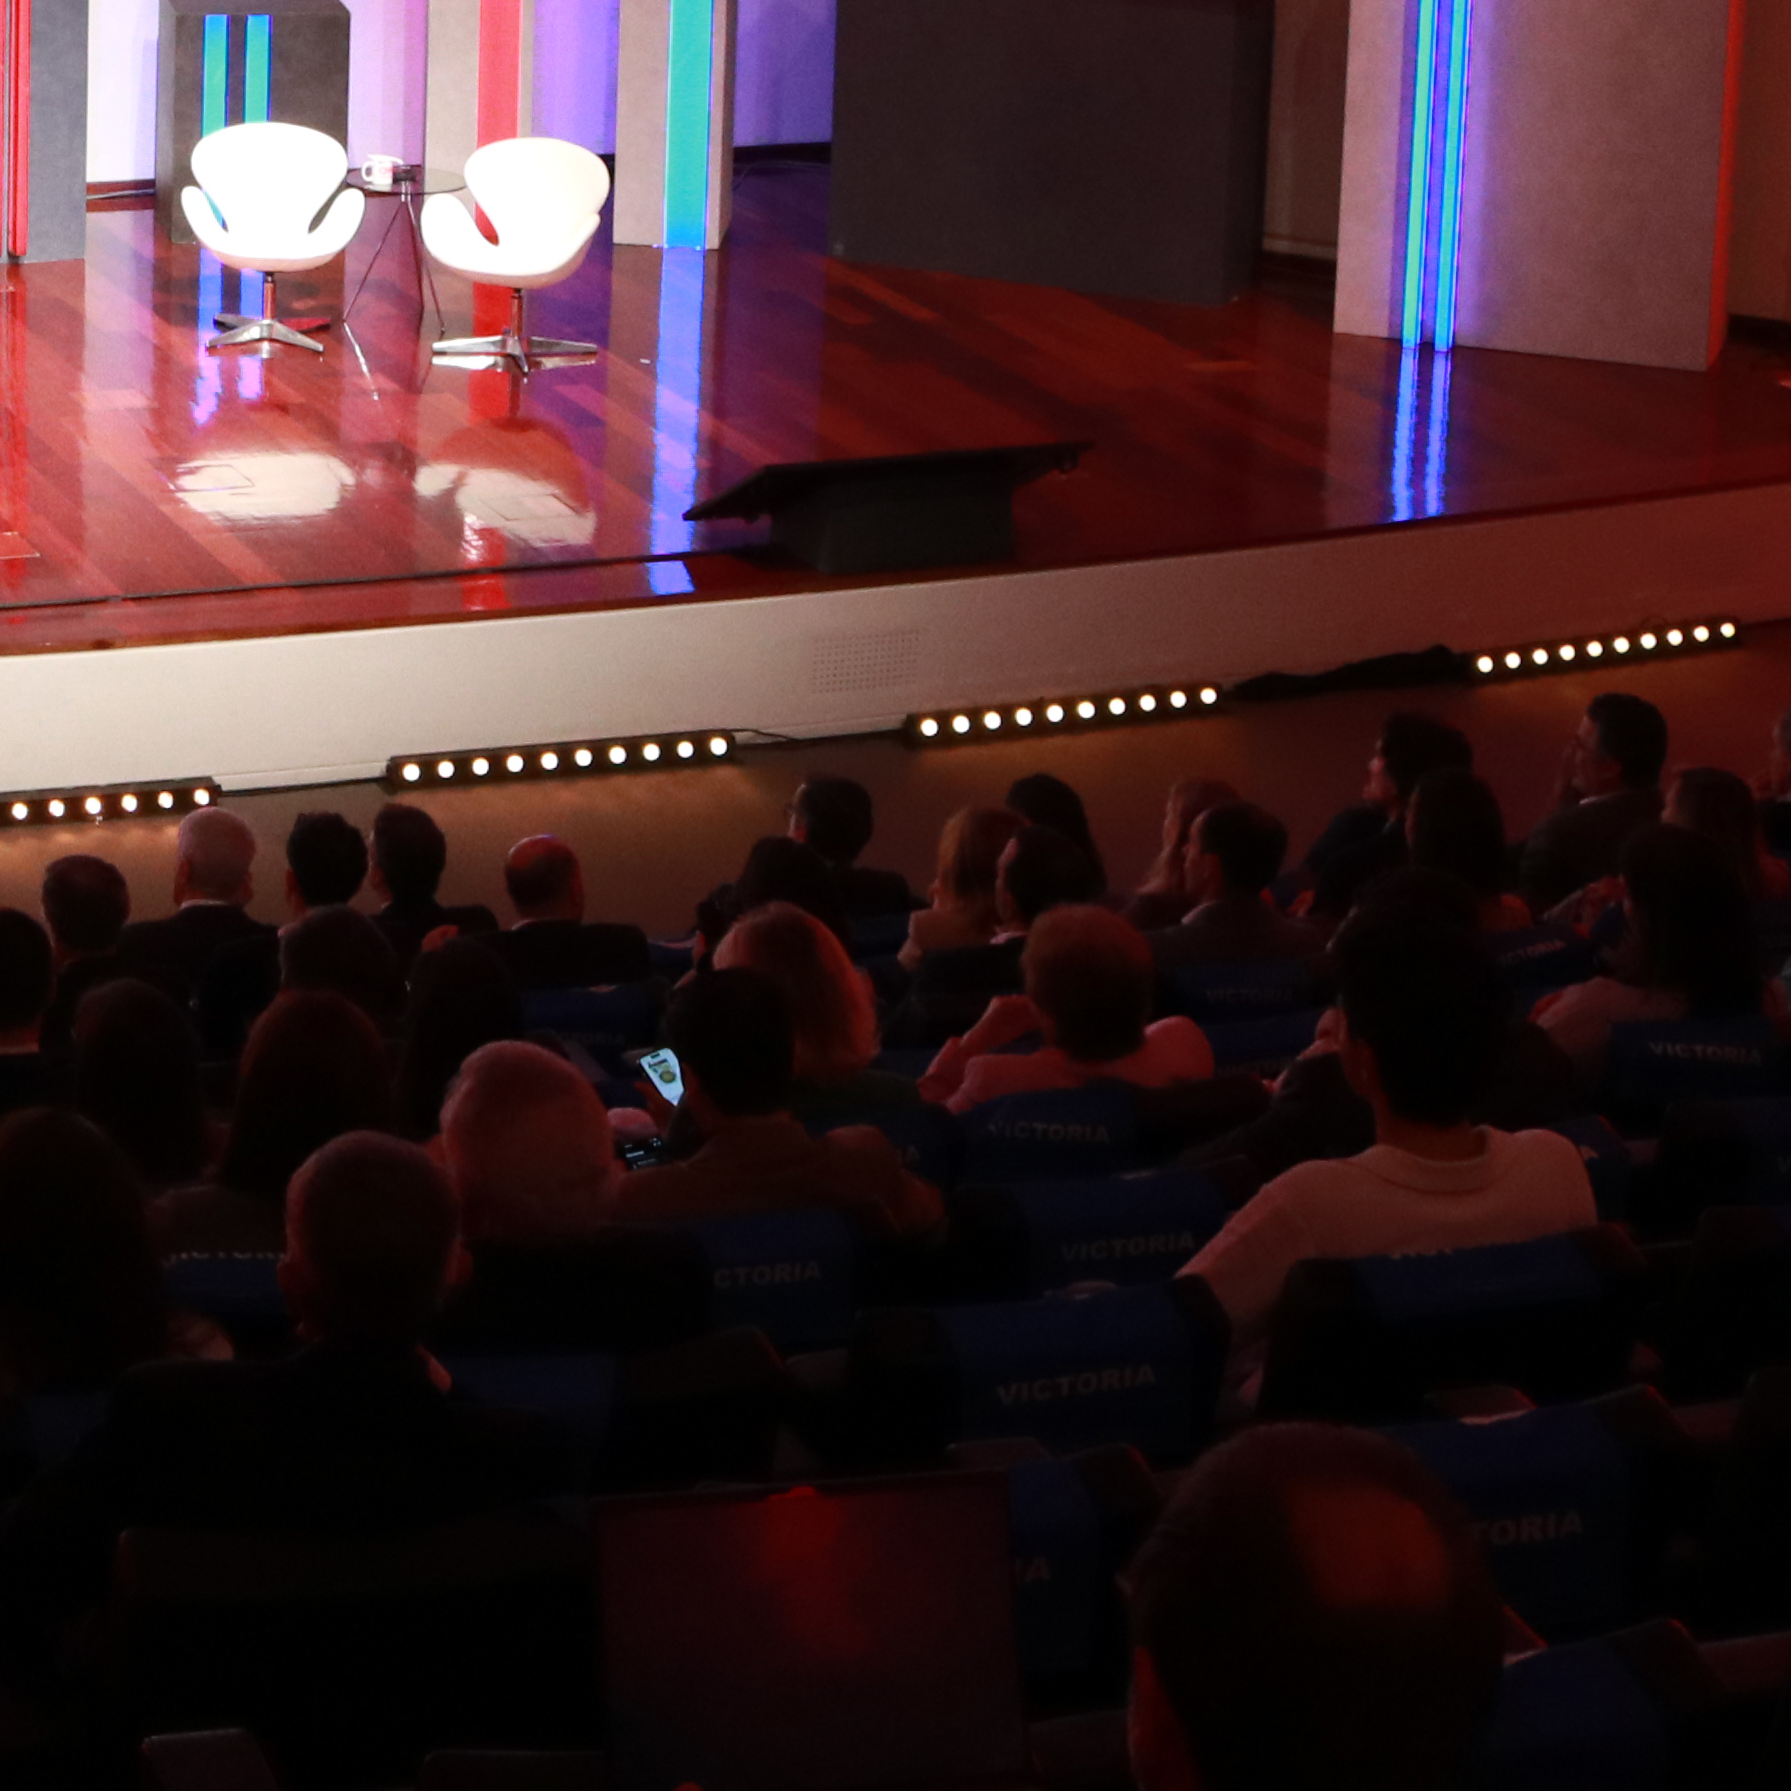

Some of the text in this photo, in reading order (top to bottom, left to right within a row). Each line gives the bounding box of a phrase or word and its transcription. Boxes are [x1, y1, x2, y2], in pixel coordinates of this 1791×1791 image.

[1060, 1229, 1196, 1264] VICTORIA
[712, 1259, 823, 1291] CTORIA
[995, 1362, 1158, 1407] VICTORIA
[1467, 1508, 1585, 1547] TORIA
